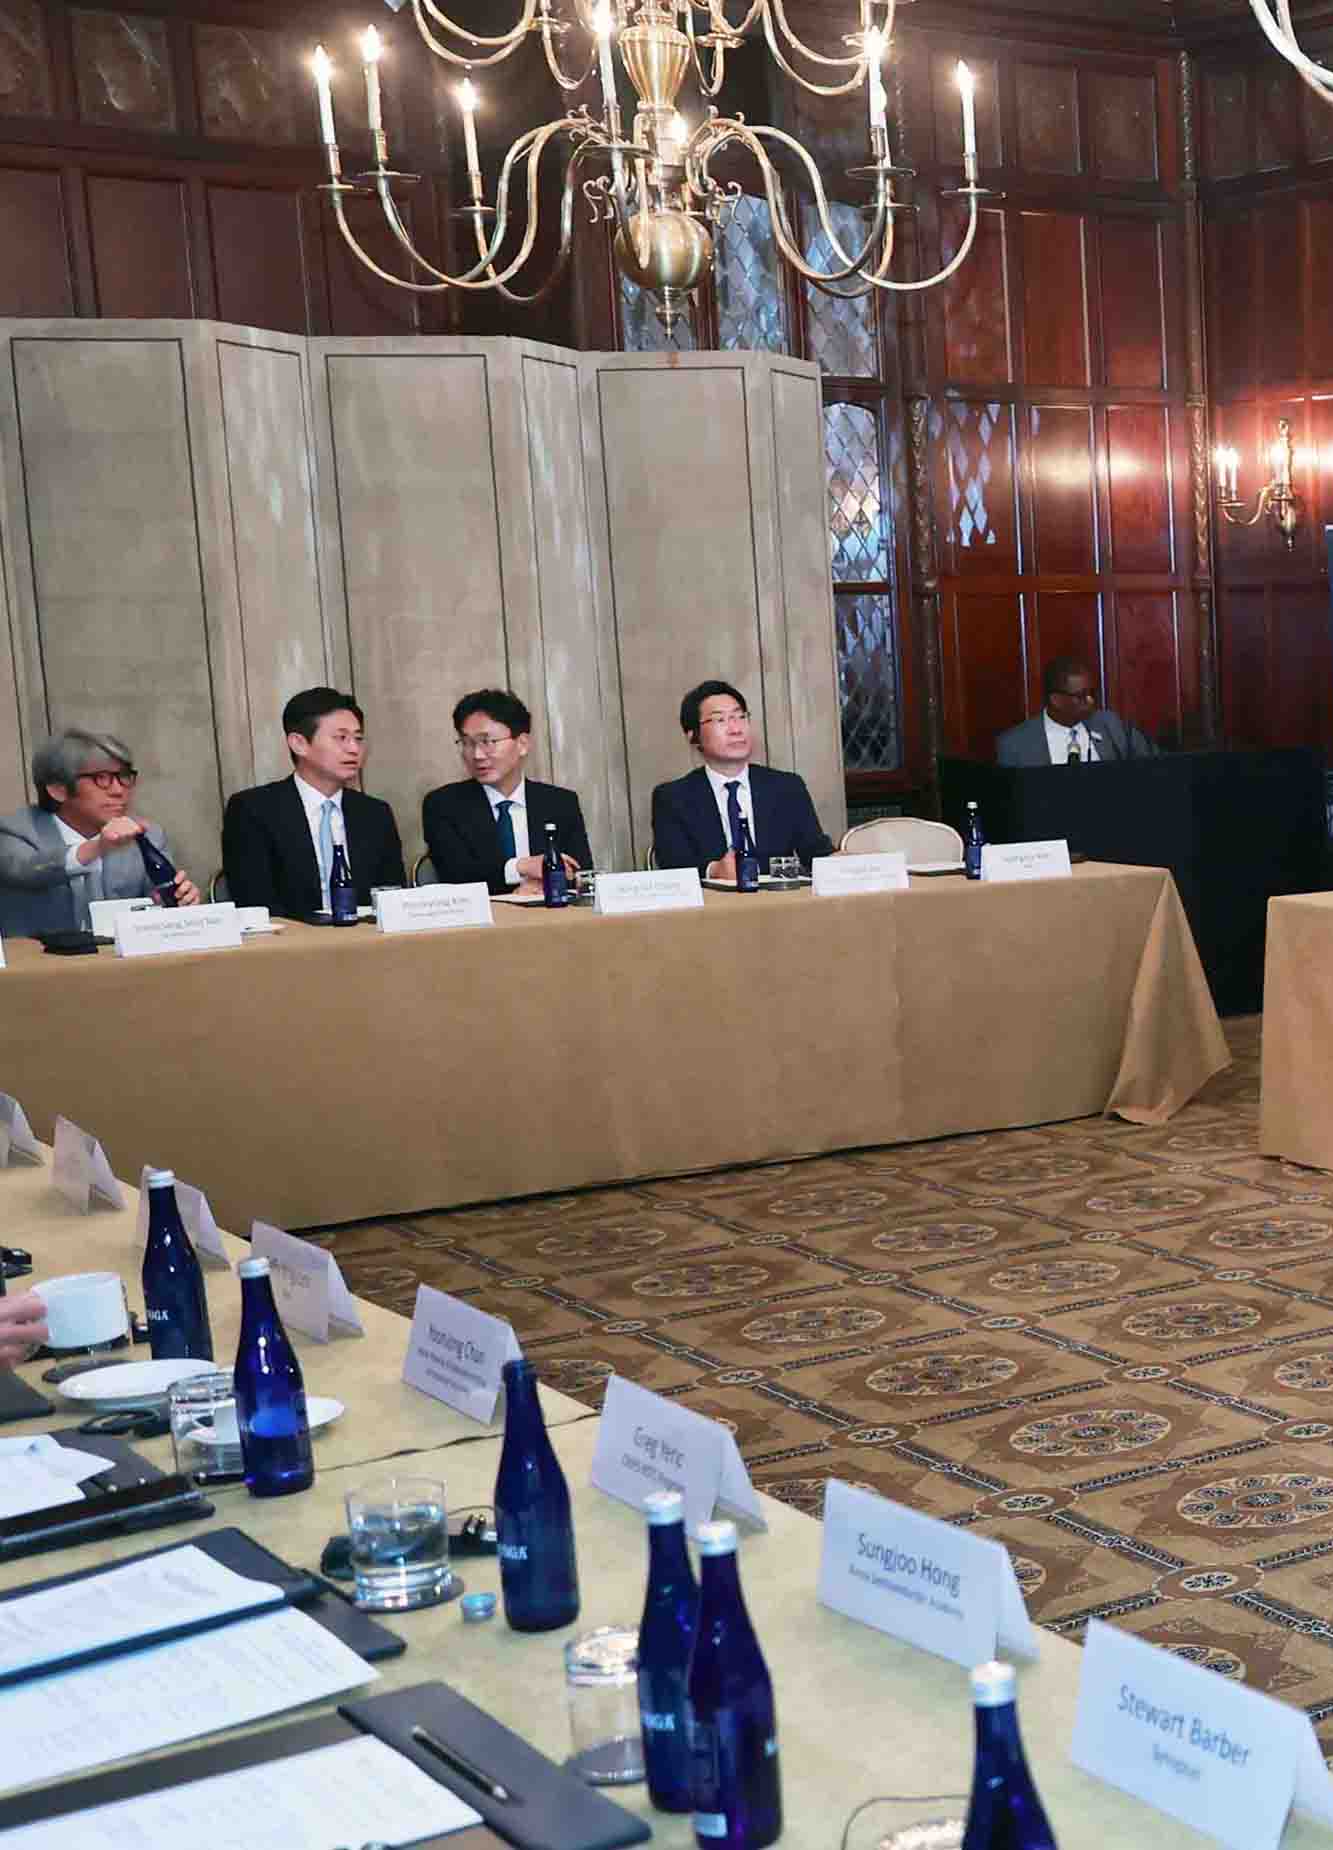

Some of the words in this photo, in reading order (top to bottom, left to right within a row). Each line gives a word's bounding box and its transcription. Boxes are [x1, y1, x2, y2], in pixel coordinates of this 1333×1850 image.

[857, 1532, 917, 1576] Sungjoo
[920, 1556, 961, 1600] Hong
[1117, 1683, 1185, 1740] Stewart
[1190, 1716, 1250, 1766] Barber
